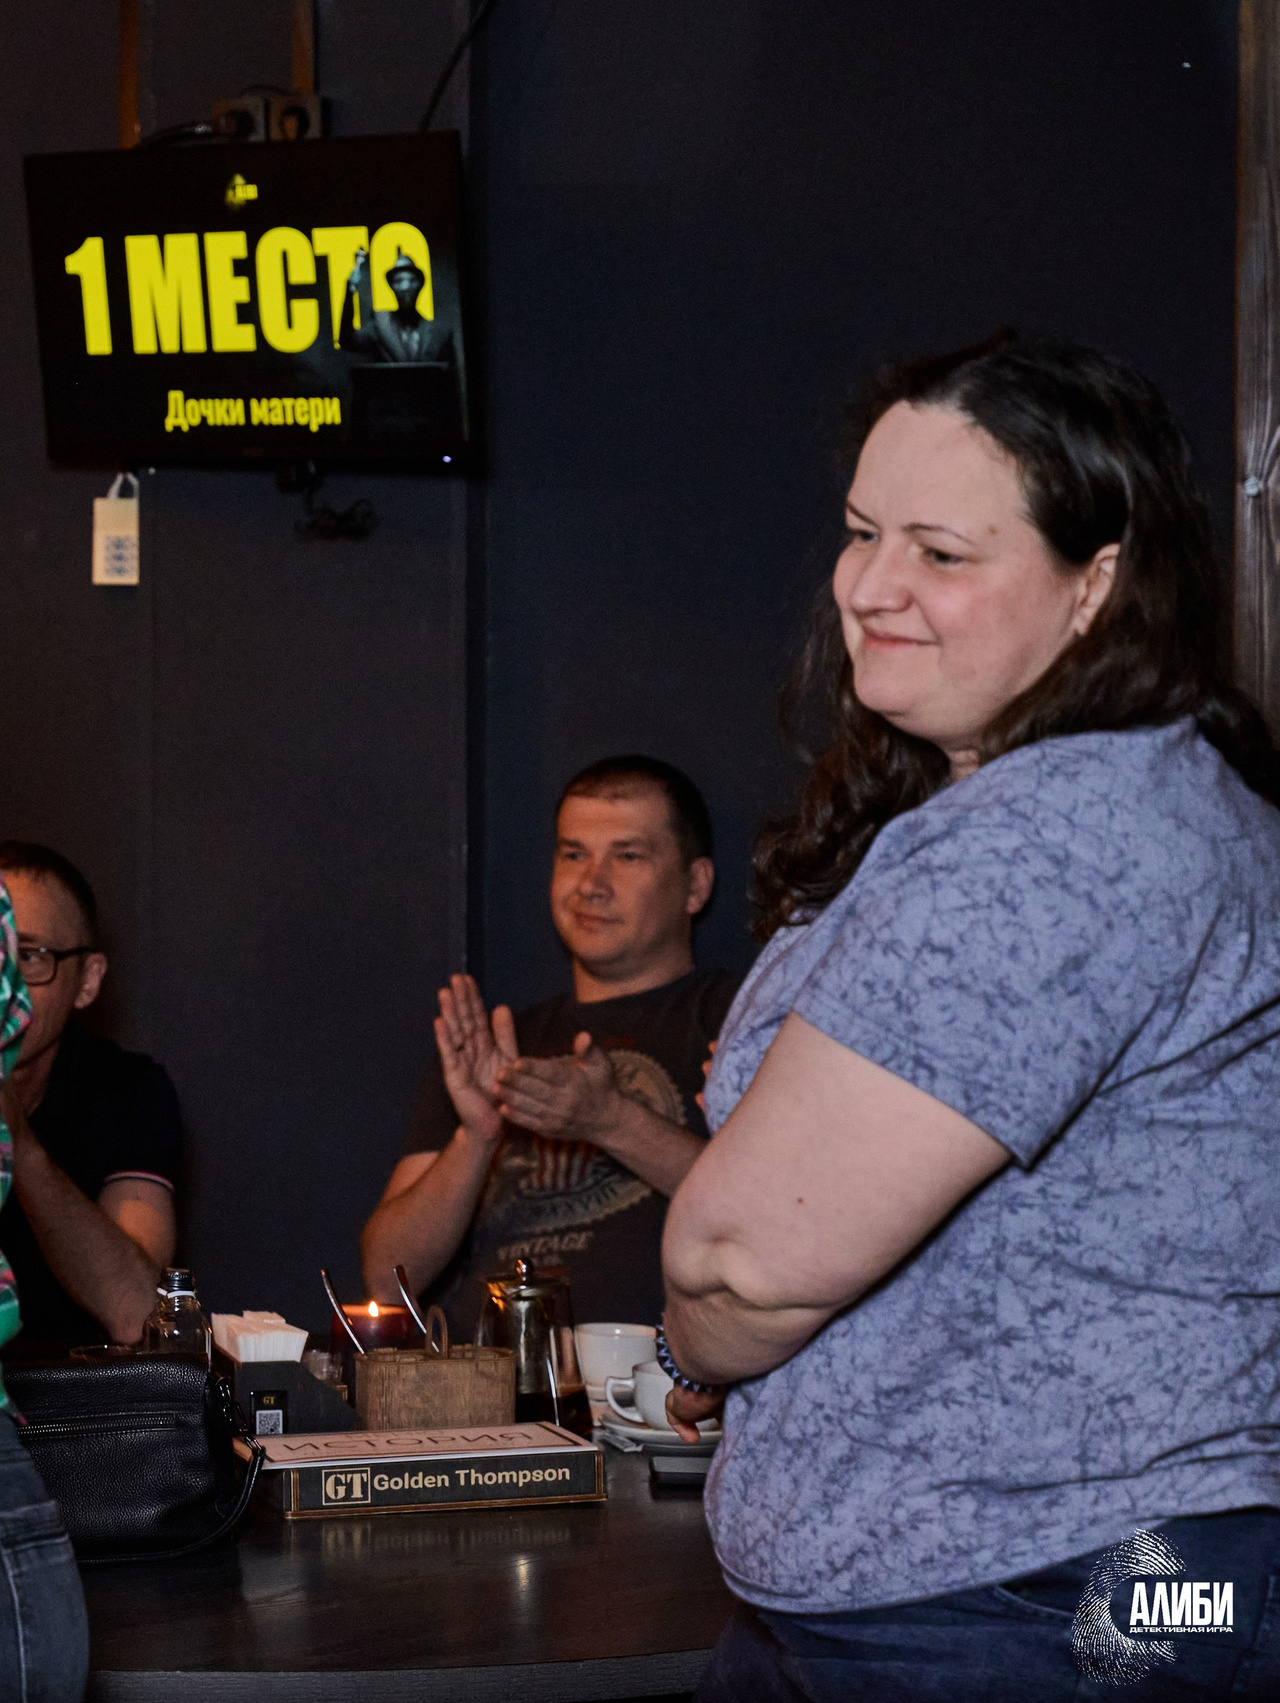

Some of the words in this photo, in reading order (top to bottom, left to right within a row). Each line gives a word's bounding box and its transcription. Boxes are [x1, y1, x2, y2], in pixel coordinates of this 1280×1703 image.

[64, 236, 113, 356] 1
[124, 221, 435, 355] МЕСТО
[164, 389, 246, 433] Дочки
[249, 396, 342, 433] матери
[282, 1431, 533, 1452] ИСТОРИЯ
[325, 1472, 369, 1501] GT
[373, 1471, 451, 1491] Golden
[454, 1467, 571, 1489] Thompson
